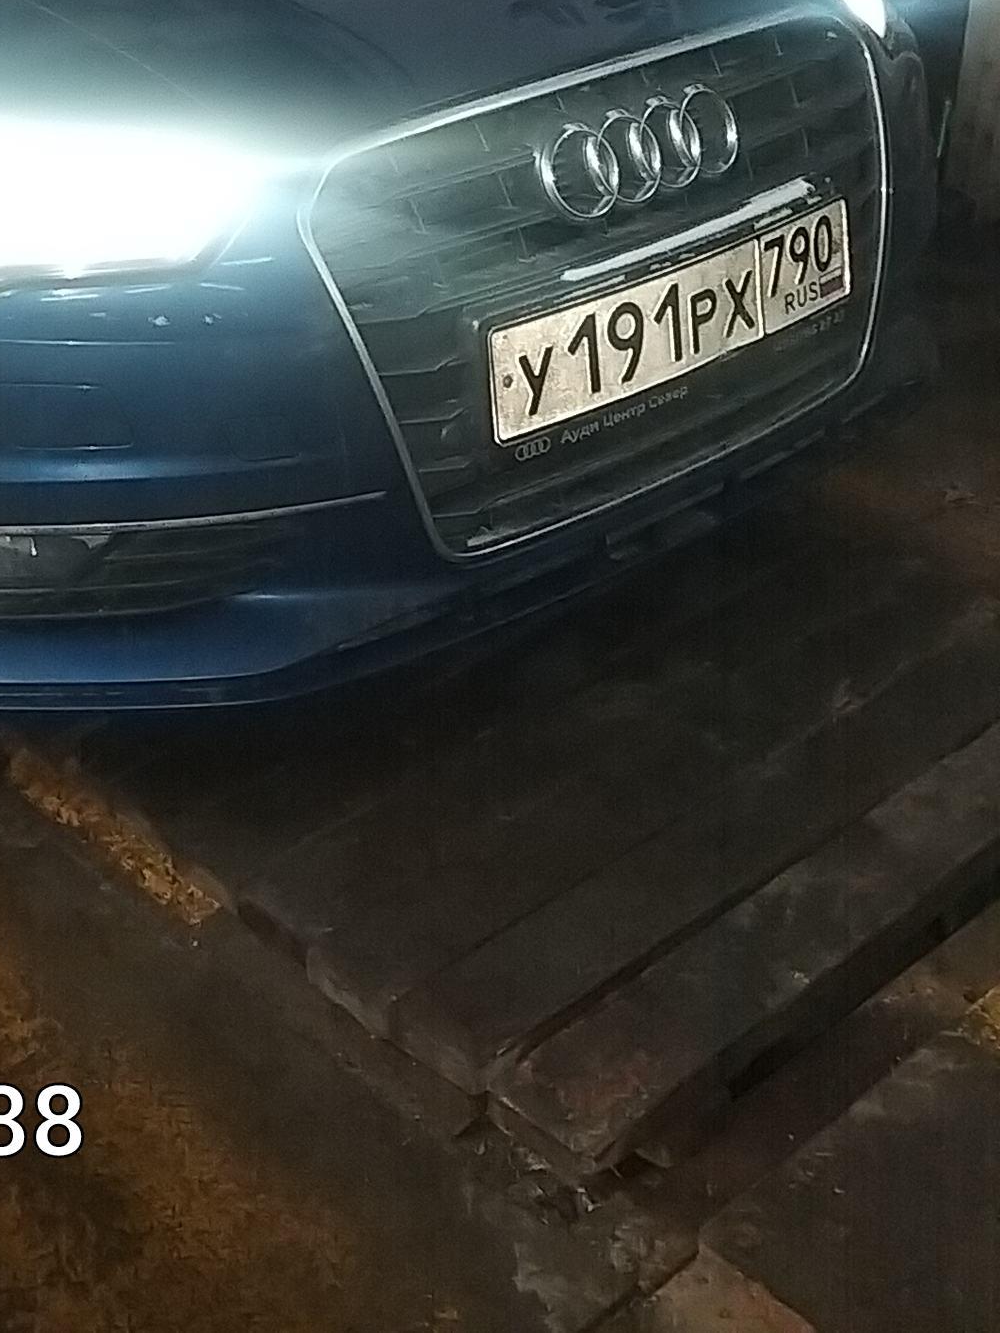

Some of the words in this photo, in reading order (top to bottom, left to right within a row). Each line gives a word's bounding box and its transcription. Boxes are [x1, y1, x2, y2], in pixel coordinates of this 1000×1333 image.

[518, 270, 756, 417] У191РХ
[764, 215, 832, 298] 790
[784, 281, 819, 315] RUS
